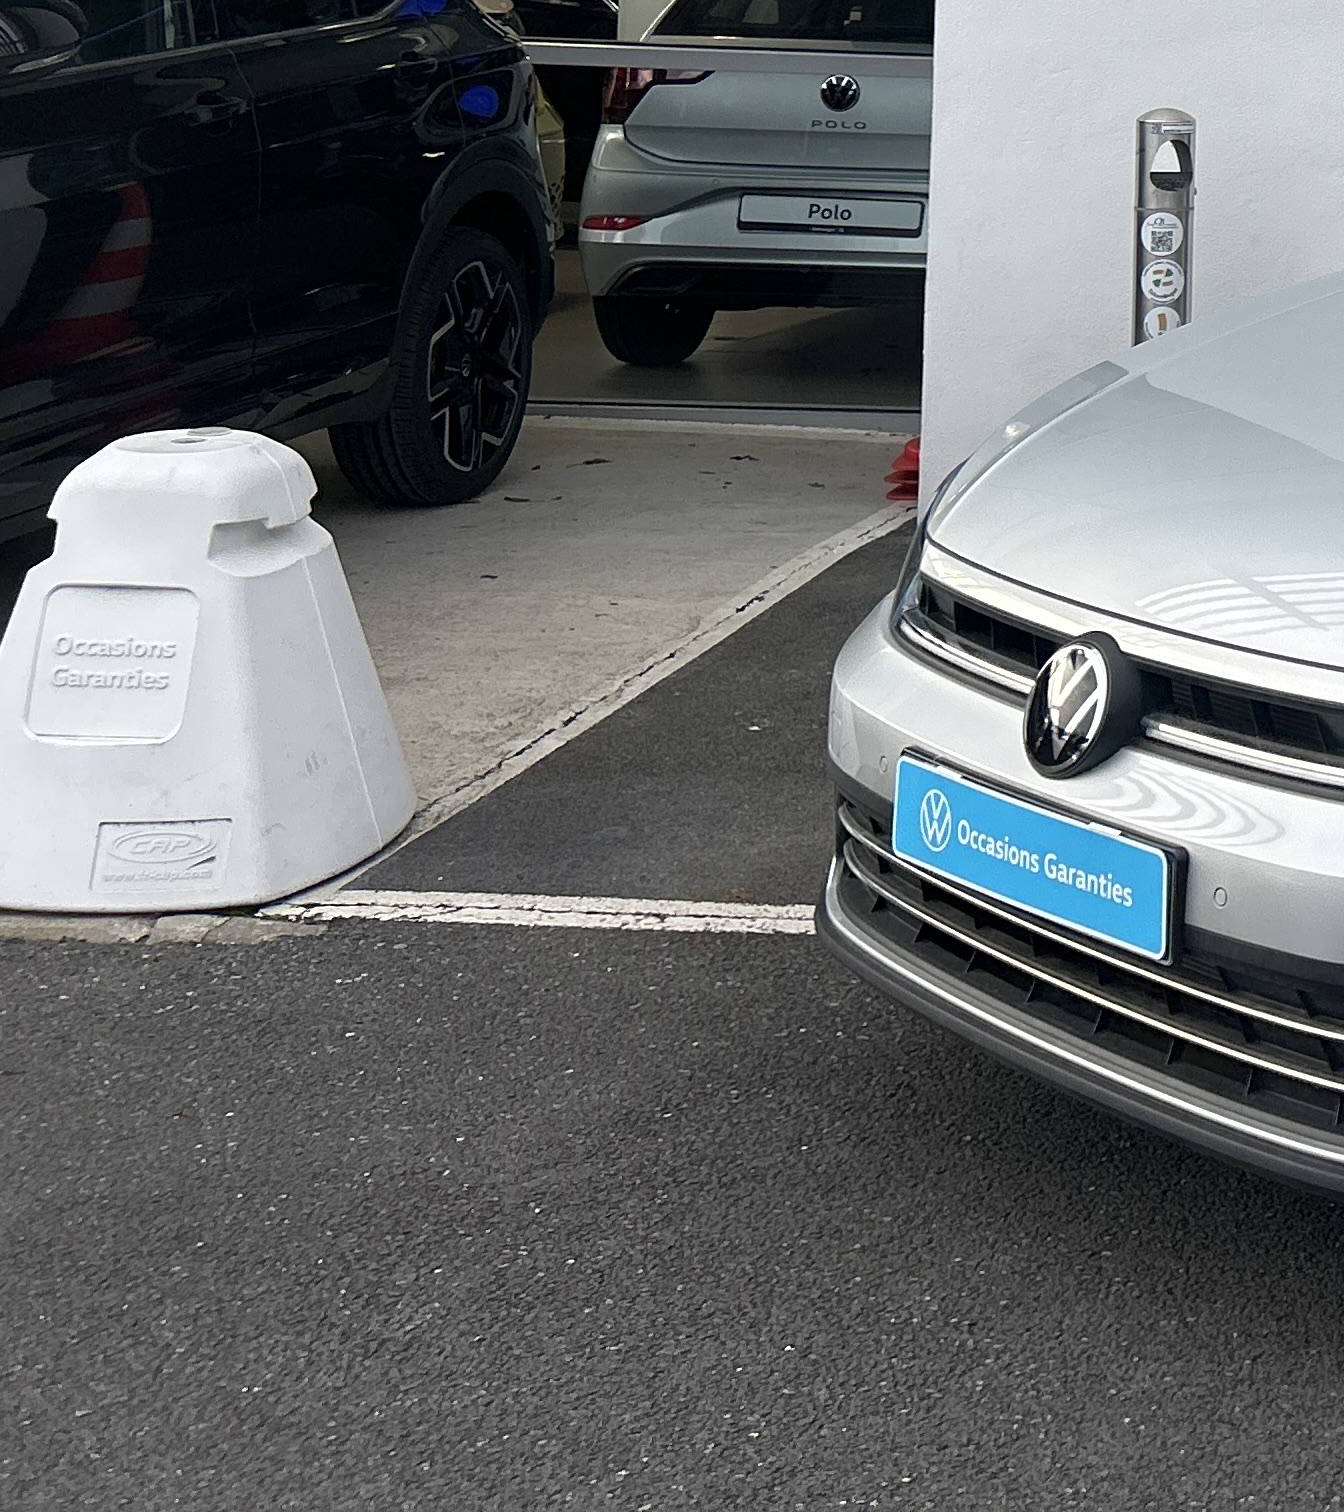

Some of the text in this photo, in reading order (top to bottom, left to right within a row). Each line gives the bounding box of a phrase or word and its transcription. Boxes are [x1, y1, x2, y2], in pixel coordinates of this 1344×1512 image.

[811, 119, 867, 129] POLO
[808, 203, 852, 222] Polo
[52, 633, 177, 660] Occasions
[51, 664, 171, 691] Garanties
[957, 819, 1039, 874] Occasions
[1043, 853, 1133, 908] Garanties
